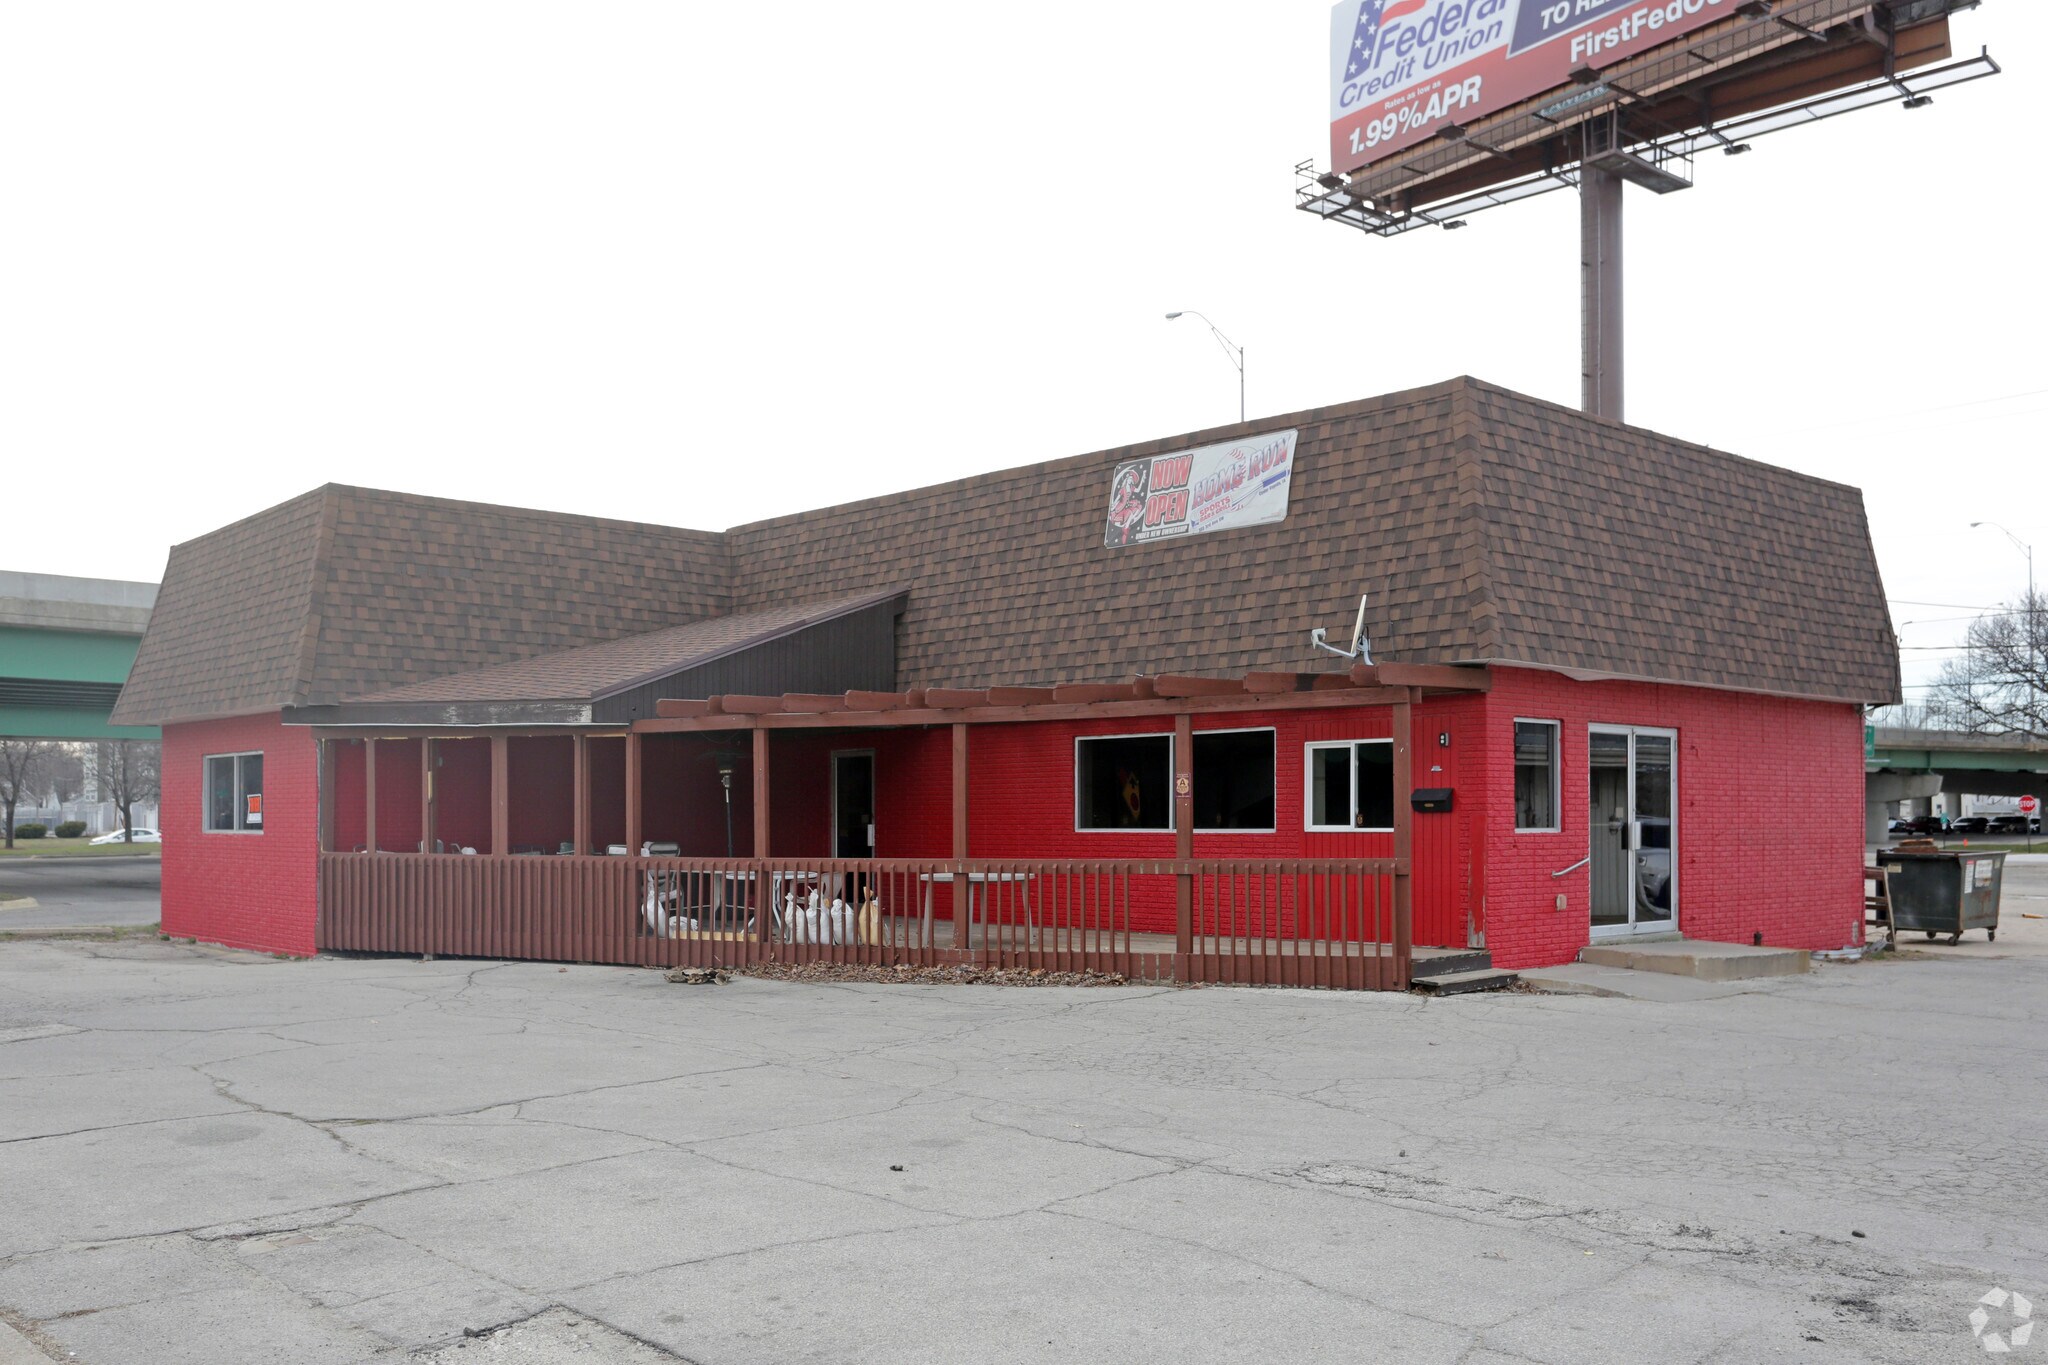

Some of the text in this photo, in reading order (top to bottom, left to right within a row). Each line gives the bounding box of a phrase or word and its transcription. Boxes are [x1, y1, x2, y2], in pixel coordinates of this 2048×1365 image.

[1540, 1, 1570, 30] TO
[1340, 20, 1503, 108] Credit Union
[1384, 80, 1442, 110] Rates as low as
[1349, 75, 1482, 155] 1.99%APR
[1150, 454, 1193, 492] NOW
[1191, 435, 1290, 510] HOME RUN
[1144, 489, 1189, 527] OPEN
[1199, 496, 1230, 516] SPORTS
[1135, 525, 1188, 540] UNDER NEW OWNERSHIP
[2018, 800, 2035, 808] STOP
